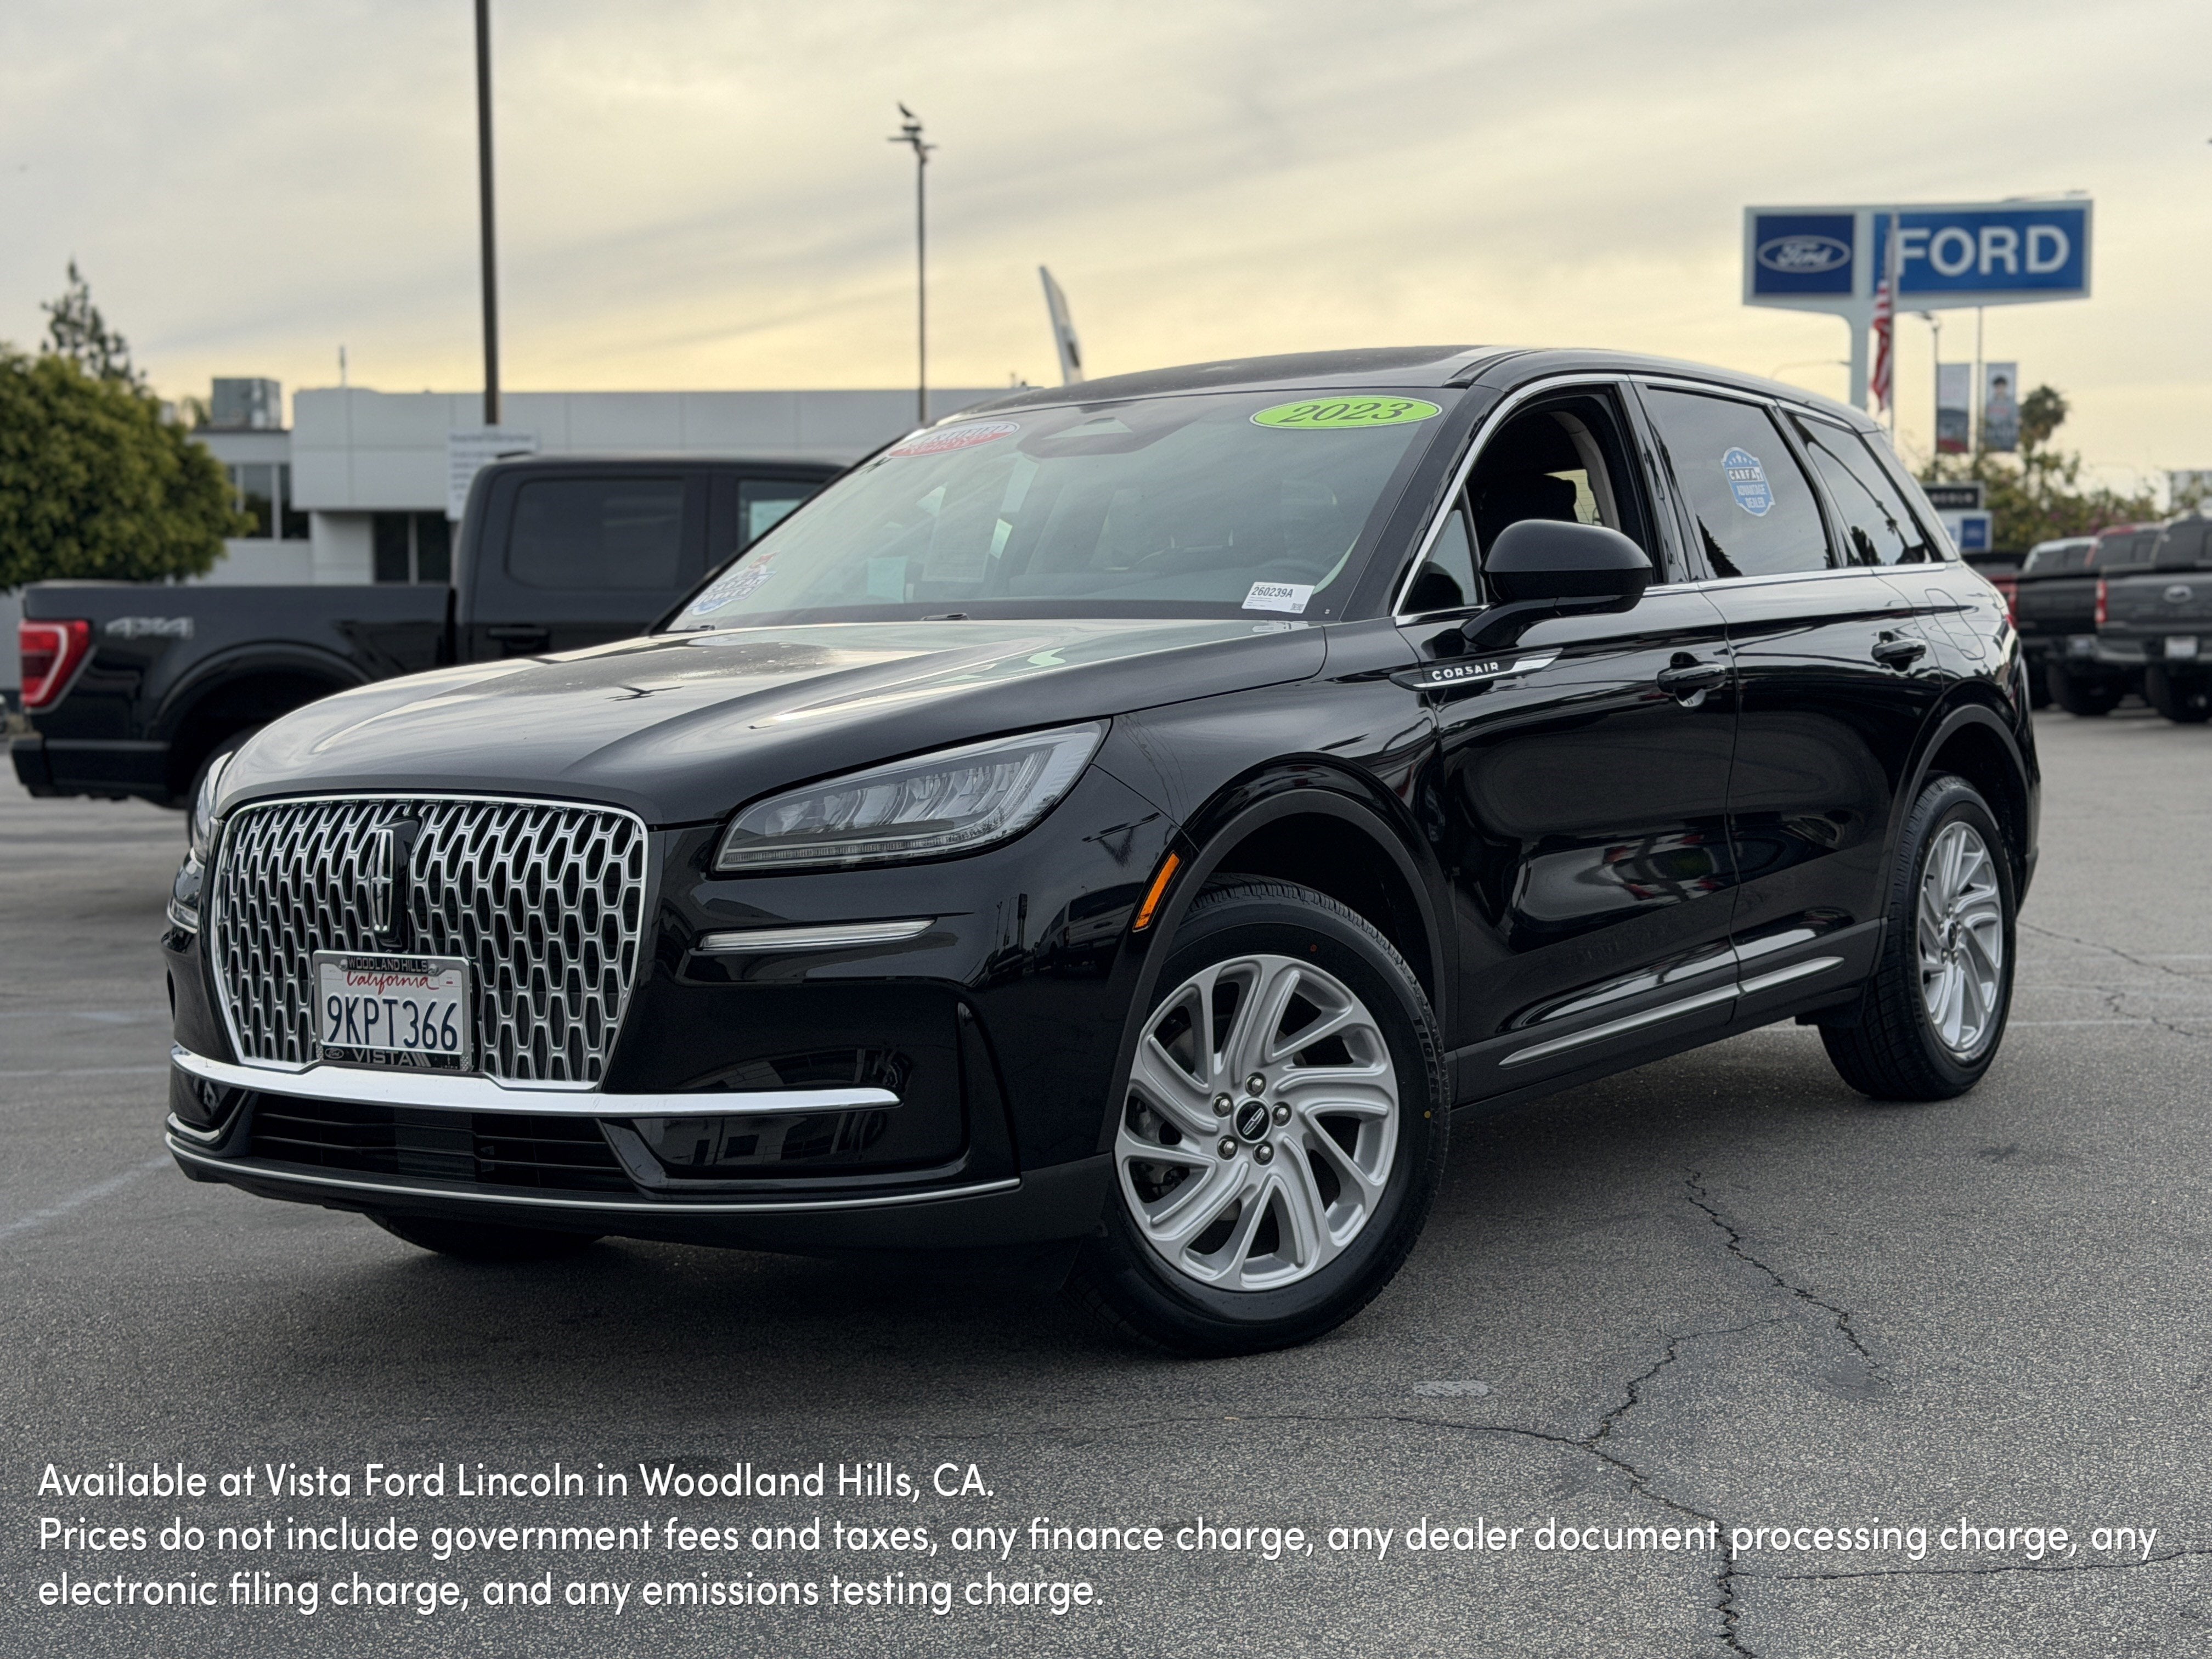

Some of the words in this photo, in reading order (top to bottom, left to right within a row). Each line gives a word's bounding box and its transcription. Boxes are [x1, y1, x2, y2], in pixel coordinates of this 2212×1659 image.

[1775, 239, 1834, 268] Ford
[1896, 224, 2070, 276] FORD
[1276, 402, 1414, 424] 2023
[1251, 586, 1294, 598] 260239A
[1432, 662, 1499, 681] CORSAIR
[347, 958, 400, 971] WOODLAND
[401, 960, 428, 972] HILLS
[346, 971, 440, 995] California
[327, 995, 458, 1051] 9KPT366
[353, 1049, 412, 1066] VISTA
